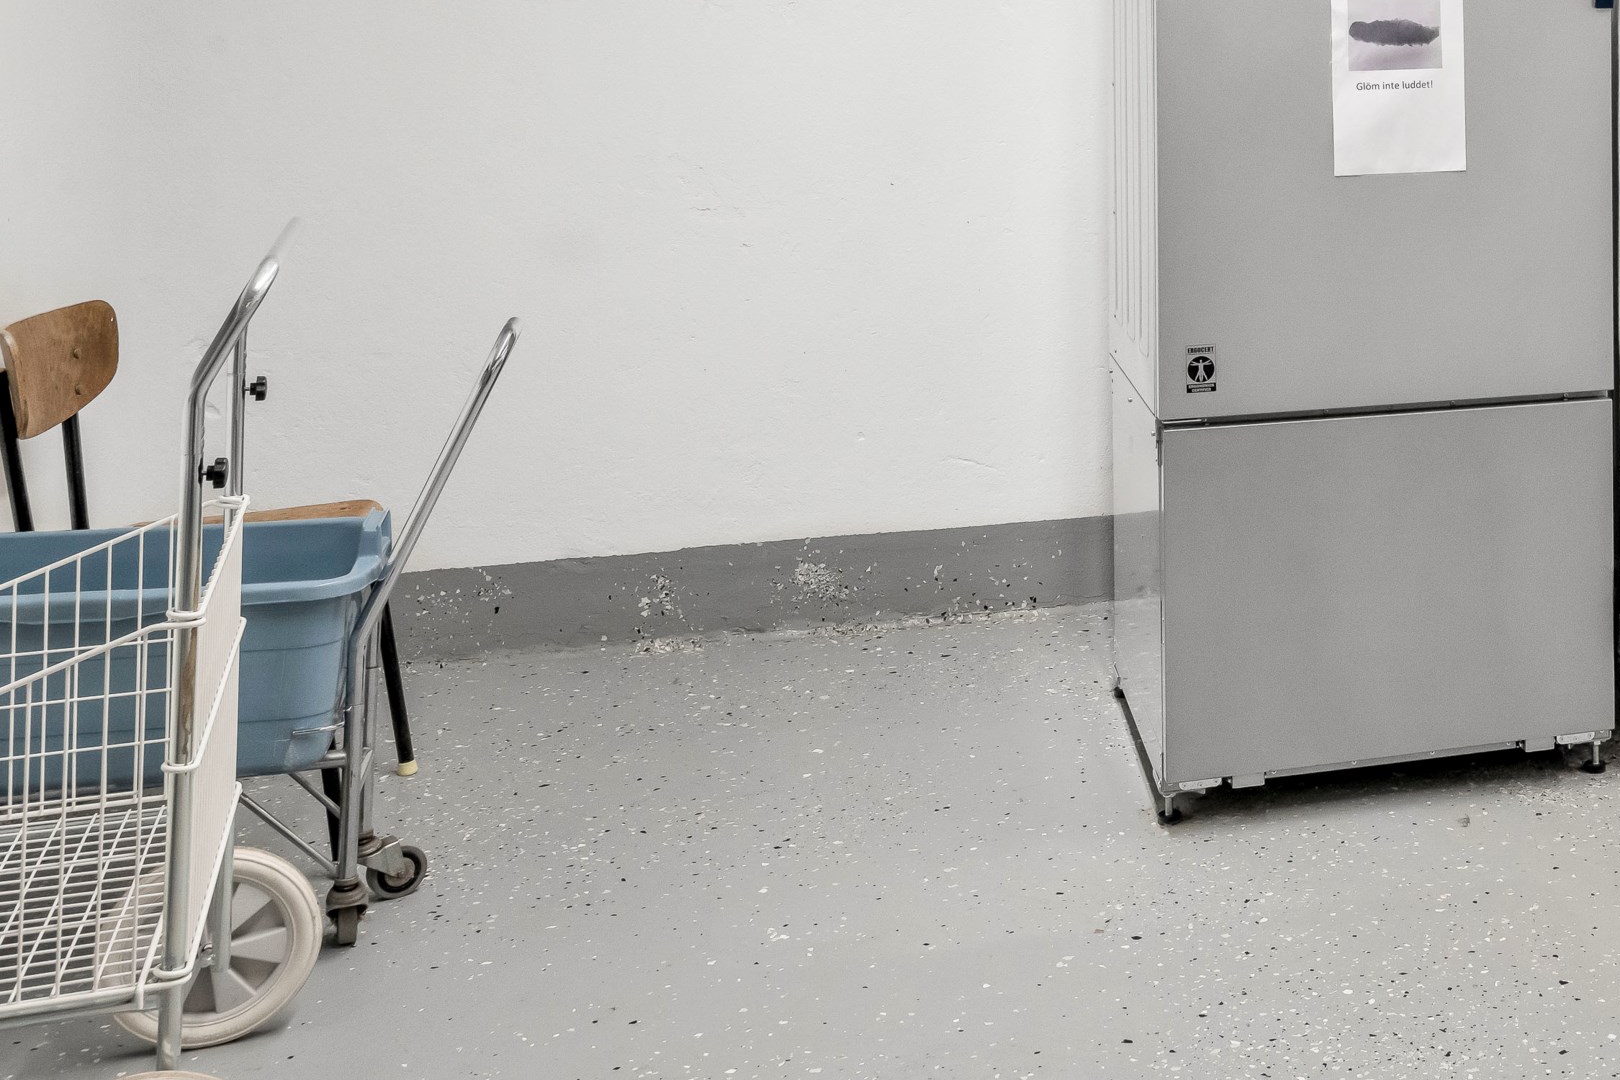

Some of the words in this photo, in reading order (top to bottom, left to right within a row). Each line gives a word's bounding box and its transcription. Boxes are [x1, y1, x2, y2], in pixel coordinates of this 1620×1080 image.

[1355, 81, 1380, 91] Glöm
[1382, 81, 1400, 91] inte
[1402, 80, 1434, 90] luddet!
